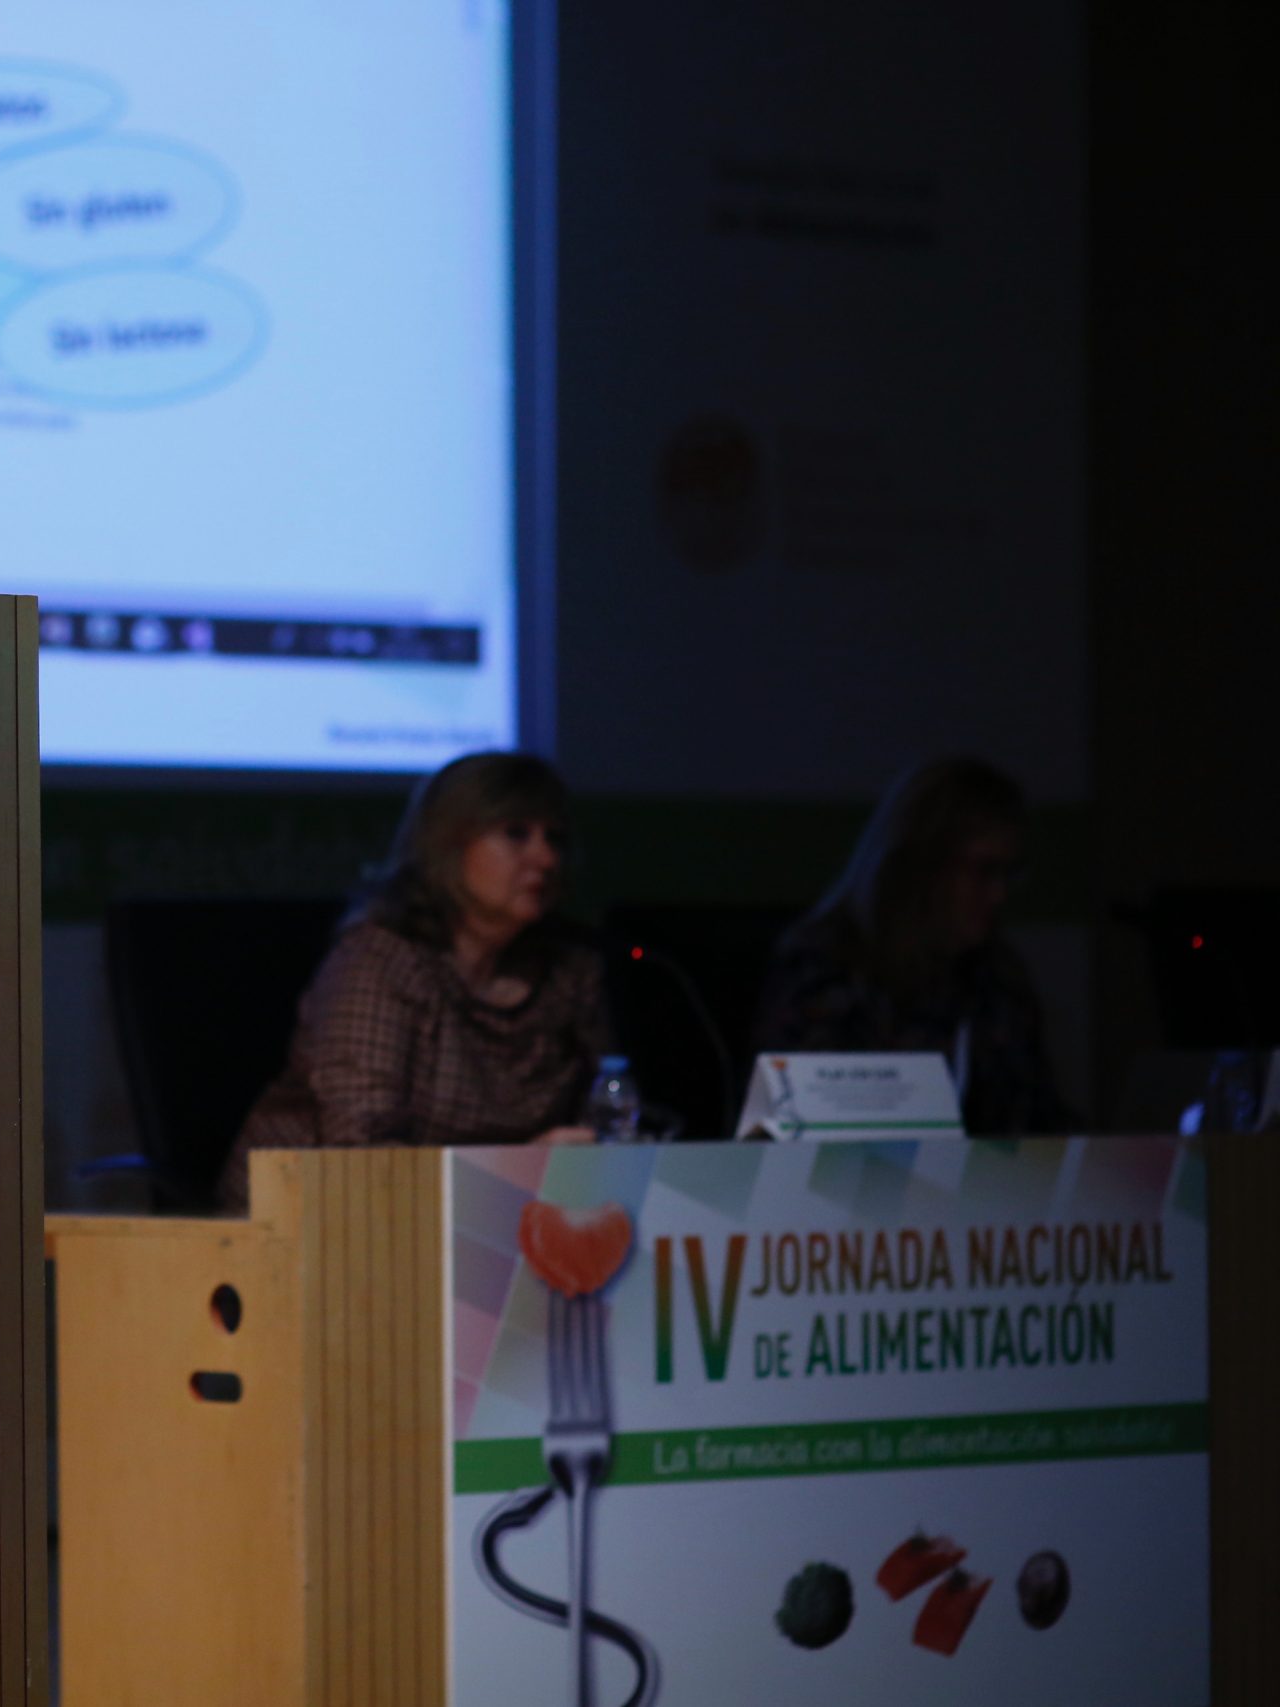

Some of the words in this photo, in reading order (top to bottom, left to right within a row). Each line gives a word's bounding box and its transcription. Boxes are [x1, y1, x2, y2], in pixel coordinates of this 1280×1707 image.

[25, 198, 66, 228] Sin
[79, 192, 171, 234] gluten
[50, 321, 93, 354] Sin
[751, 1228, 954, 1298] JORNADA
[967, 1220, 1175, 1291] NACIONAL
[655, 1234, 747, 1384] IV
[754, 1331, 791, 1380] DE
[805, 1285, 1116, 1377] ALIMENTACIÓN
[653, 1439, 689, 1475] La
[695, 1433, 811, 1471] farmacia
[813, 1435, 862, 1464] con
[868, 1428, 894, 1462] la
[897, 1425, 1056, 1461] alimentación
